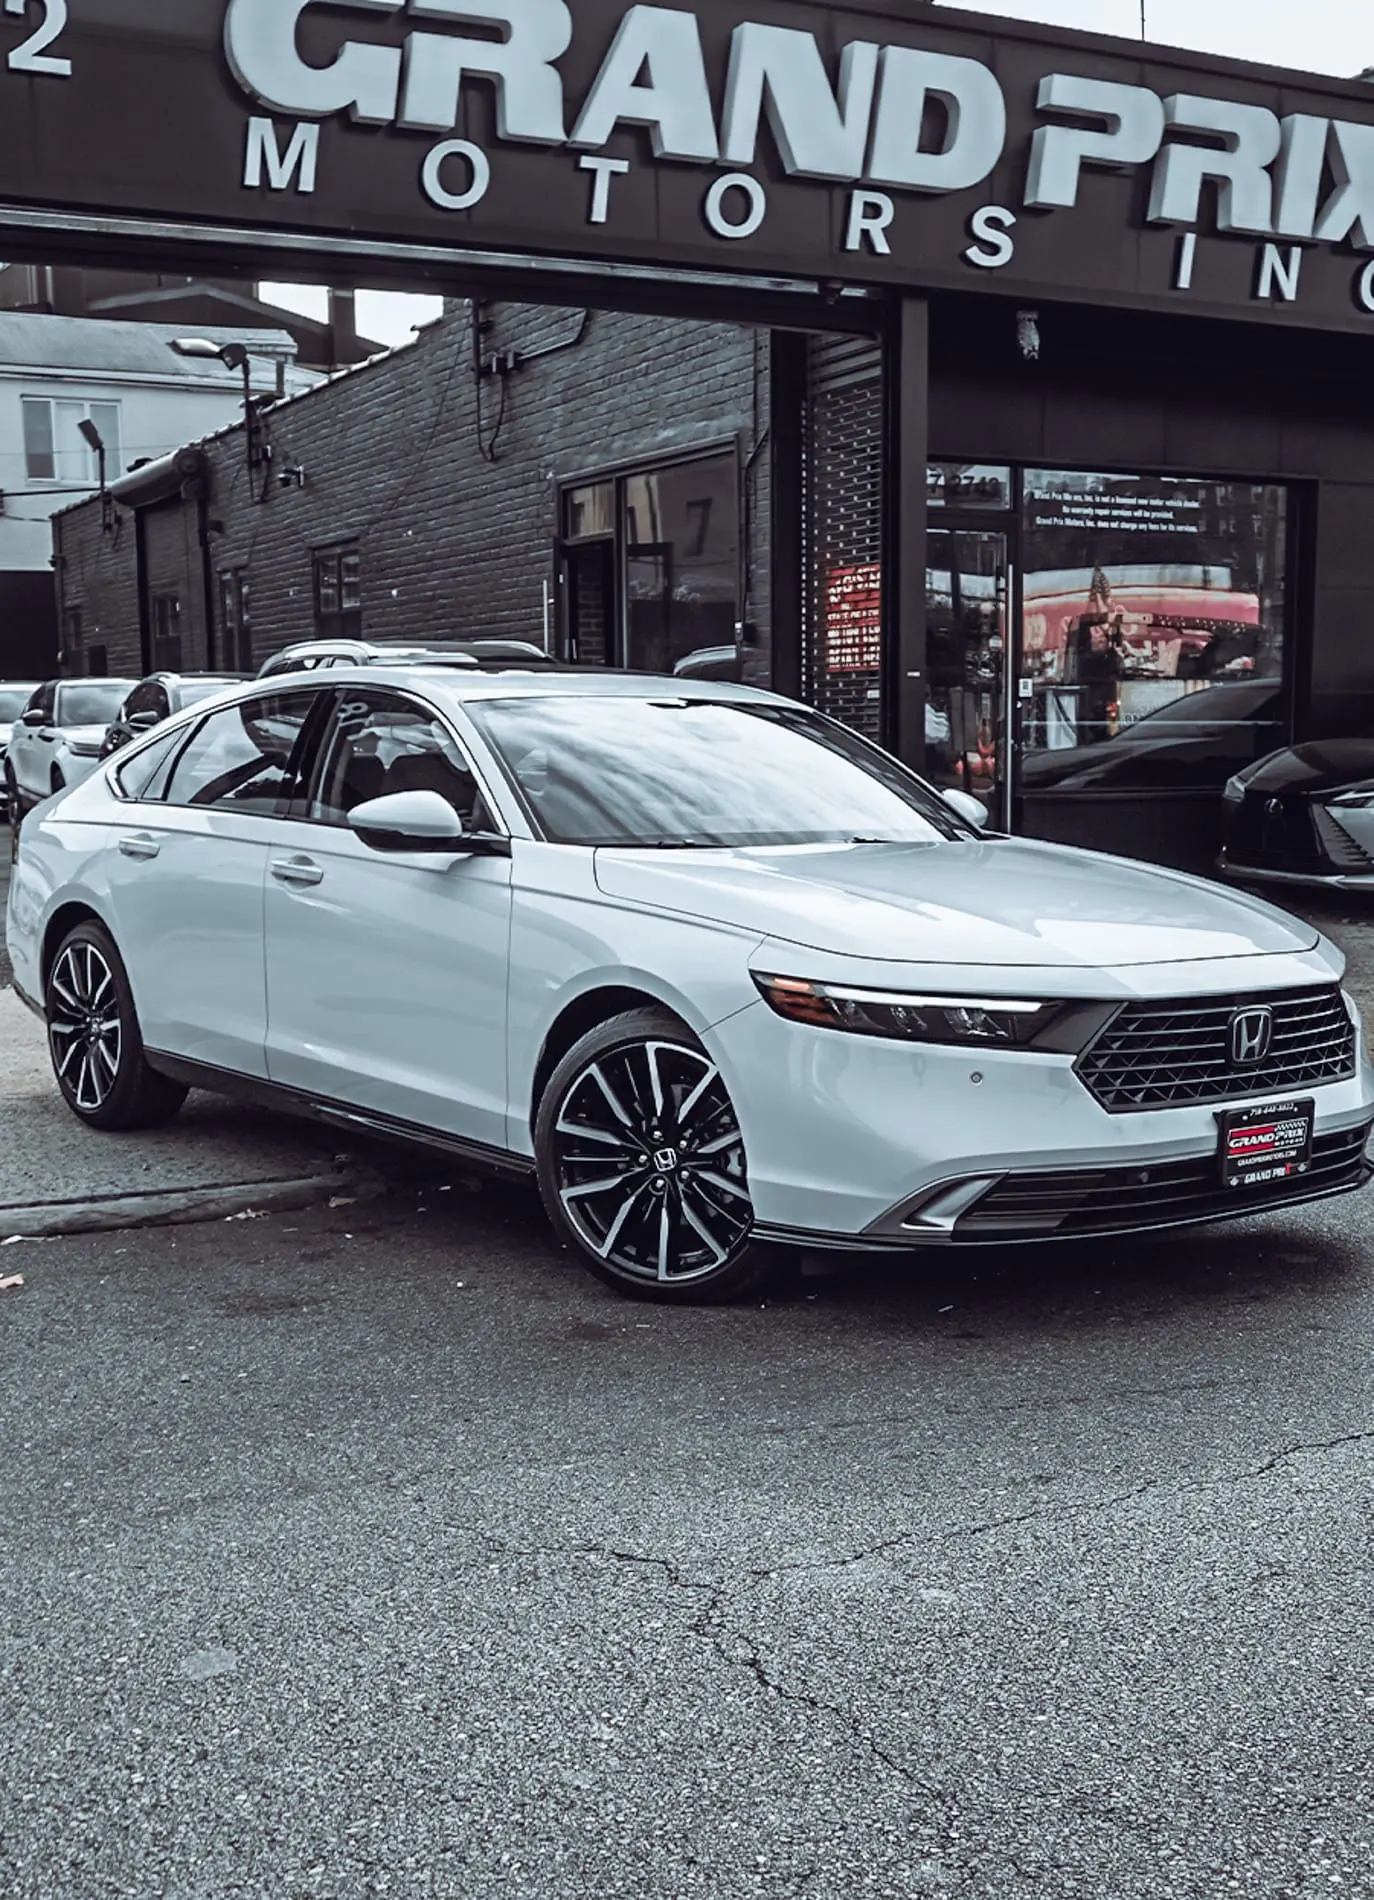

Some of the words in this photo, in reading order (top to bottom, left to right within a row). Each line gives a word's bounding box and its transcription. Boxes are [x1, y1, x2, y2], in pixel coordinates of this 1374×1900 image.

[223, 0, 1006, 194] GRAND
[243, 116, 1017, 268] MOTORS
[1036, 516, 1053, 526] Grand
[1053, 516, 1064, 526] Prix
[1110, 520, 1119, 529] not
[1229, 1133, 1275, 1148] GRAND
[1275, 1128, 1305, 1140] PRIX
[1244, 1169, 1272, 1184] GRAND
